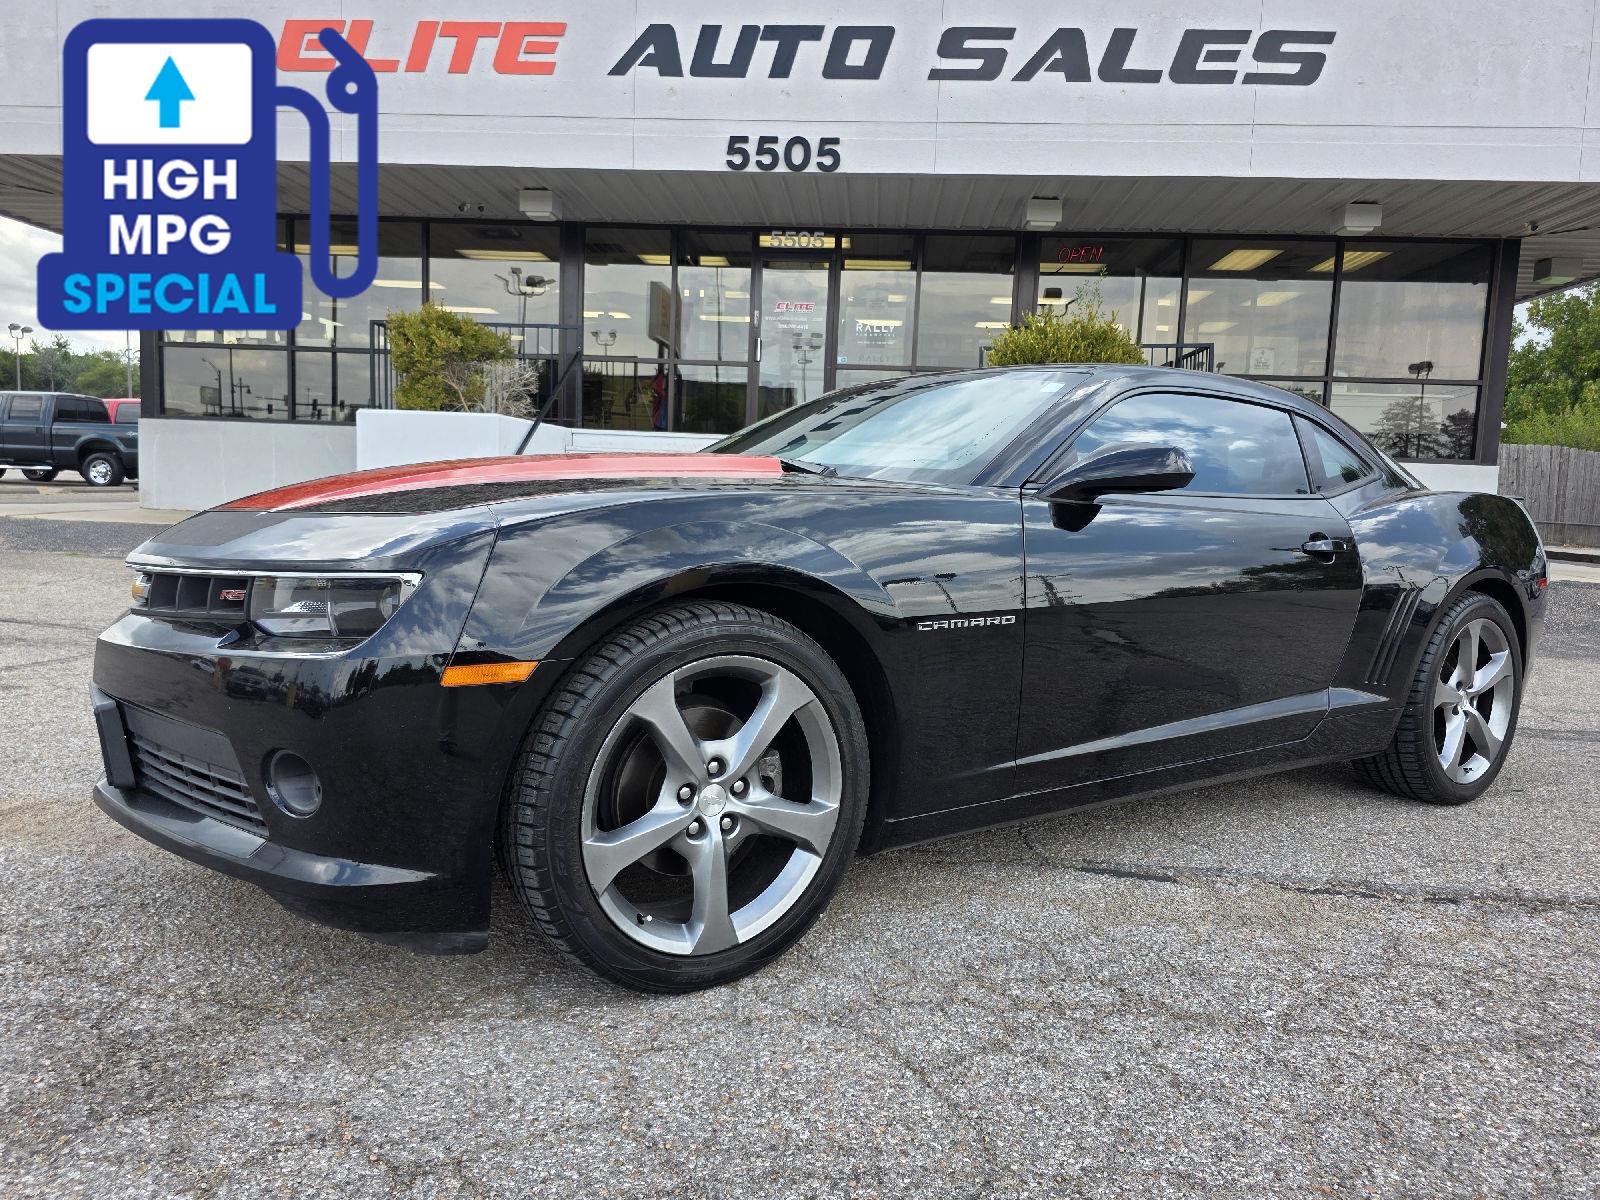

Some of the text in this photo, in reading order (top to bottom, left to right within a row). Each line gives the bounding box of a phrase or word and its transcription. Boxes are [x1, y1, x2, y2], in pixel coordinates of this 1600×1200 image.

[277, 19, 1337, 86] ELITE AUTO SALES
[726, 136, 841, 172] 5505
[770, 231, 825, 249] 5505
[1058, 246, 1103, 262] OPEN
[855, 324, 895, 332] RALLY
[219, 589, 246, 600] RS
[917, 615, 1016, 631] CAMARO
